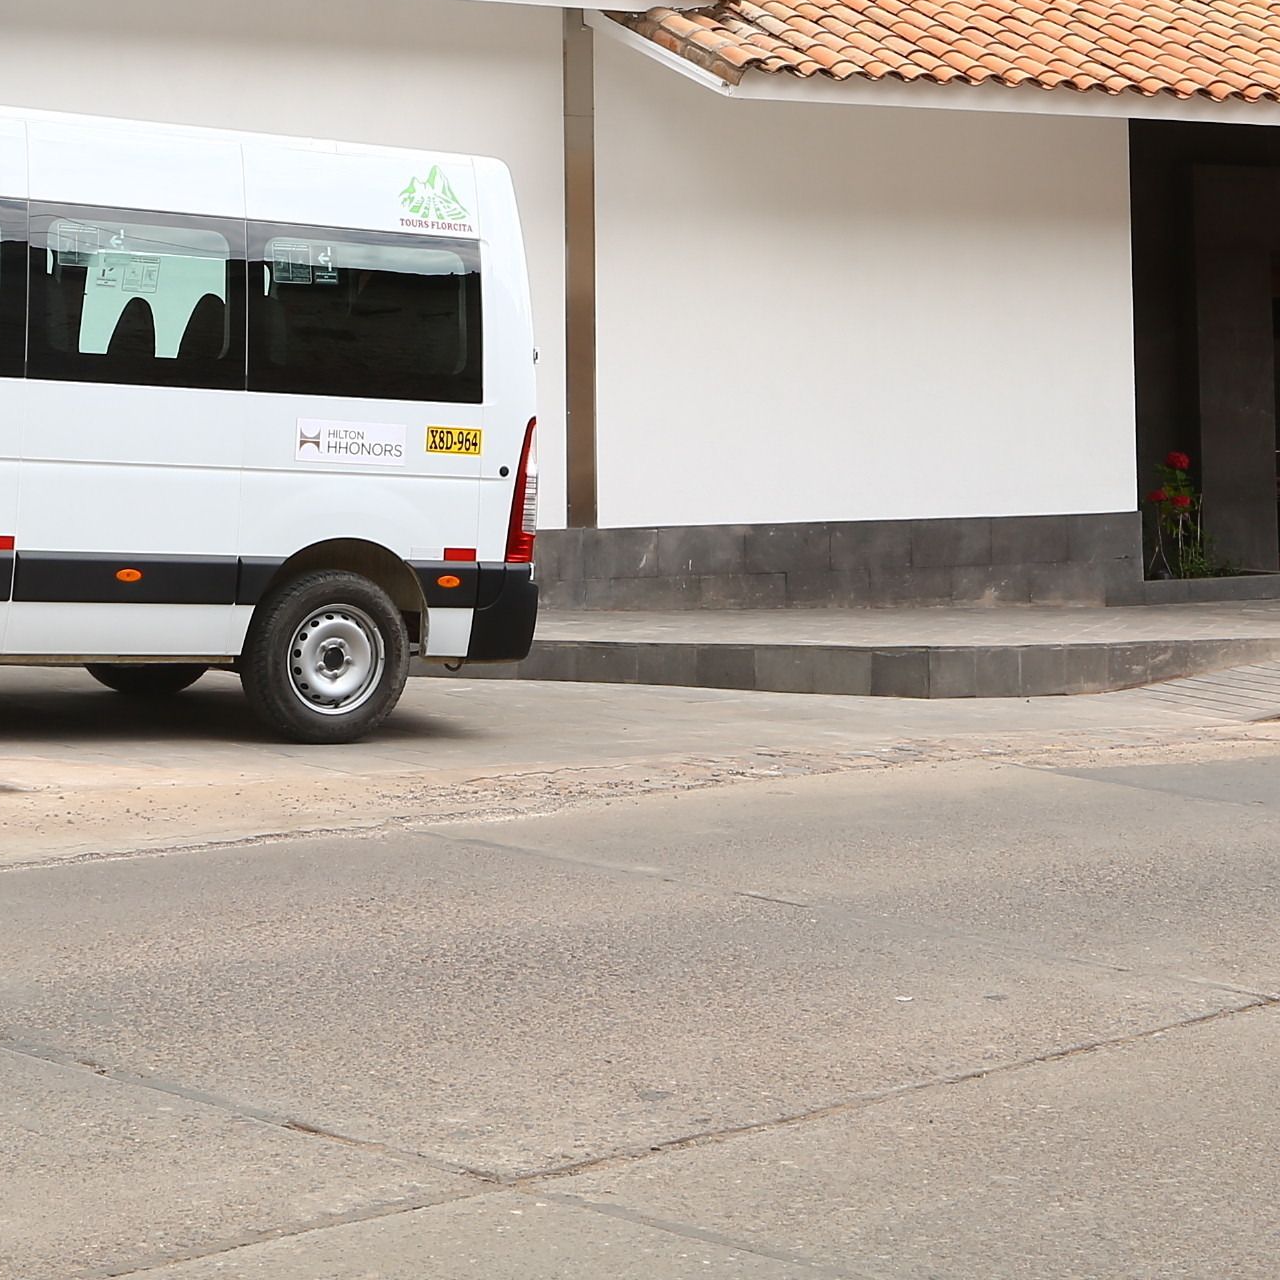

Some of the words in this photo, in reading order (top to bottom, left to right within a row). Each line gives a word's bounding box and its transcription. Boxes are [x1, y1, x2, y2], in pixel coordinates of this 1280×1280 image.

[400, 218, 429, 228] TOURS
[328, 429, 365, 441] HILTON
[429, 429, 479, 452] X8D-964
[327, 441, 403, 458] HHONORS
